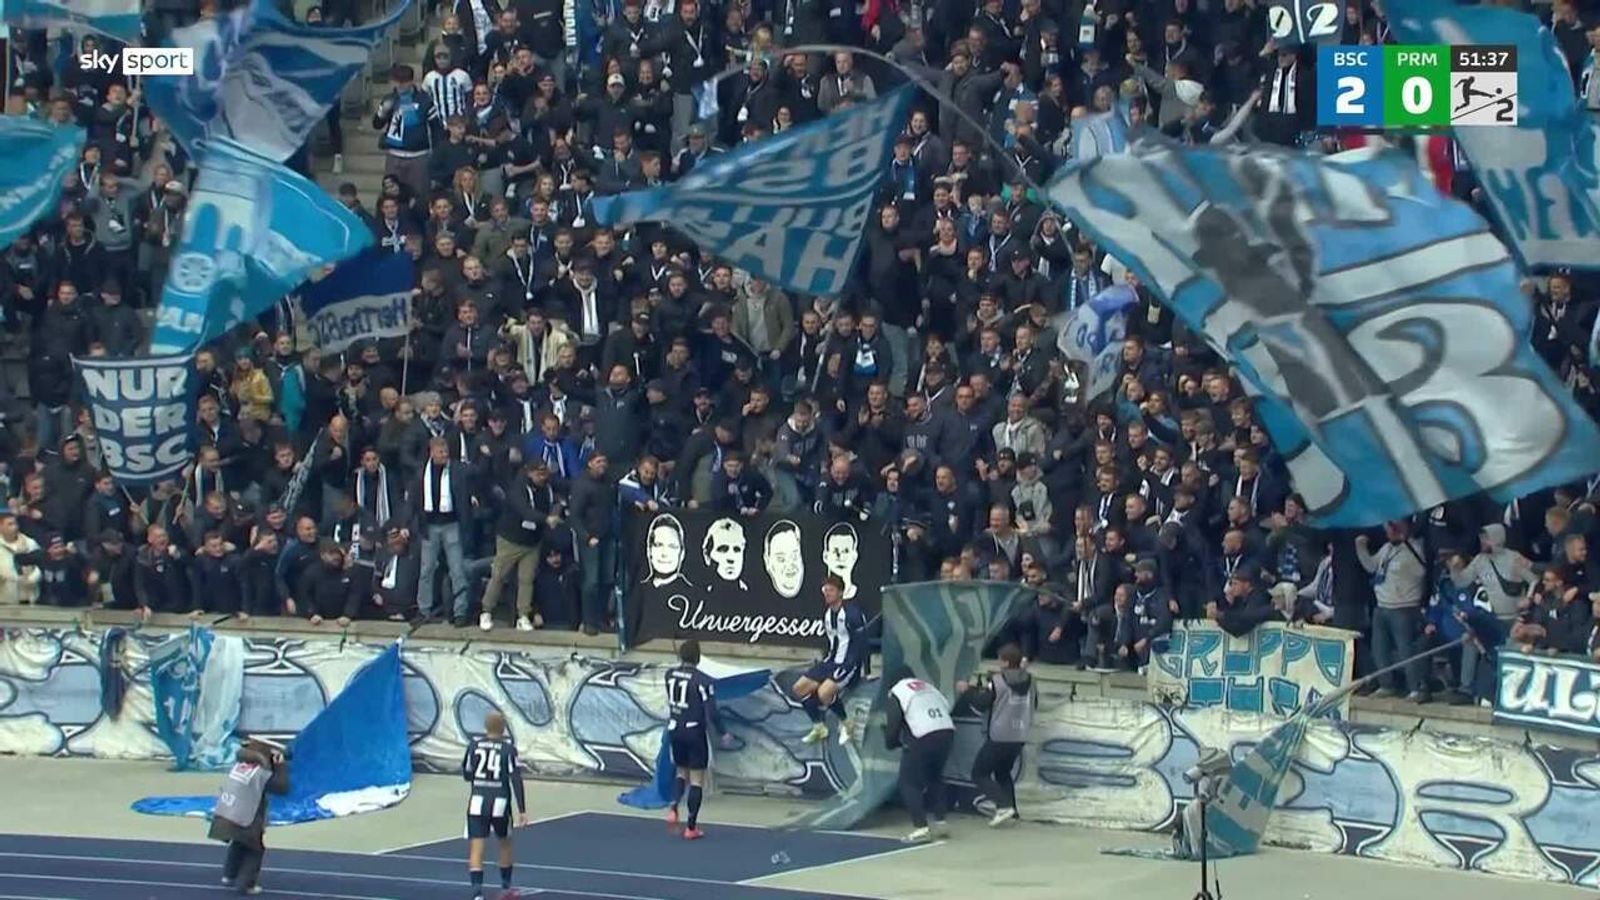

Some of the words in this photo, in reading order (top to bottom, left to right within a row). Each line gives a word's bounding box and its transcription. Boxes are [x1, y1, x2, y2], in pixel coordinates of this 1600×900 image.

[81, 366, 188, 402] NUR
[93, 402, 187, 438] DER
[101, 433, 192, 472] BSC
[667, 594, 826, 643] Unvergessen
[668, 678, 689, 709] 11
[927, 708, 943, 719] 01
[474, 748, 501, 780] 24
